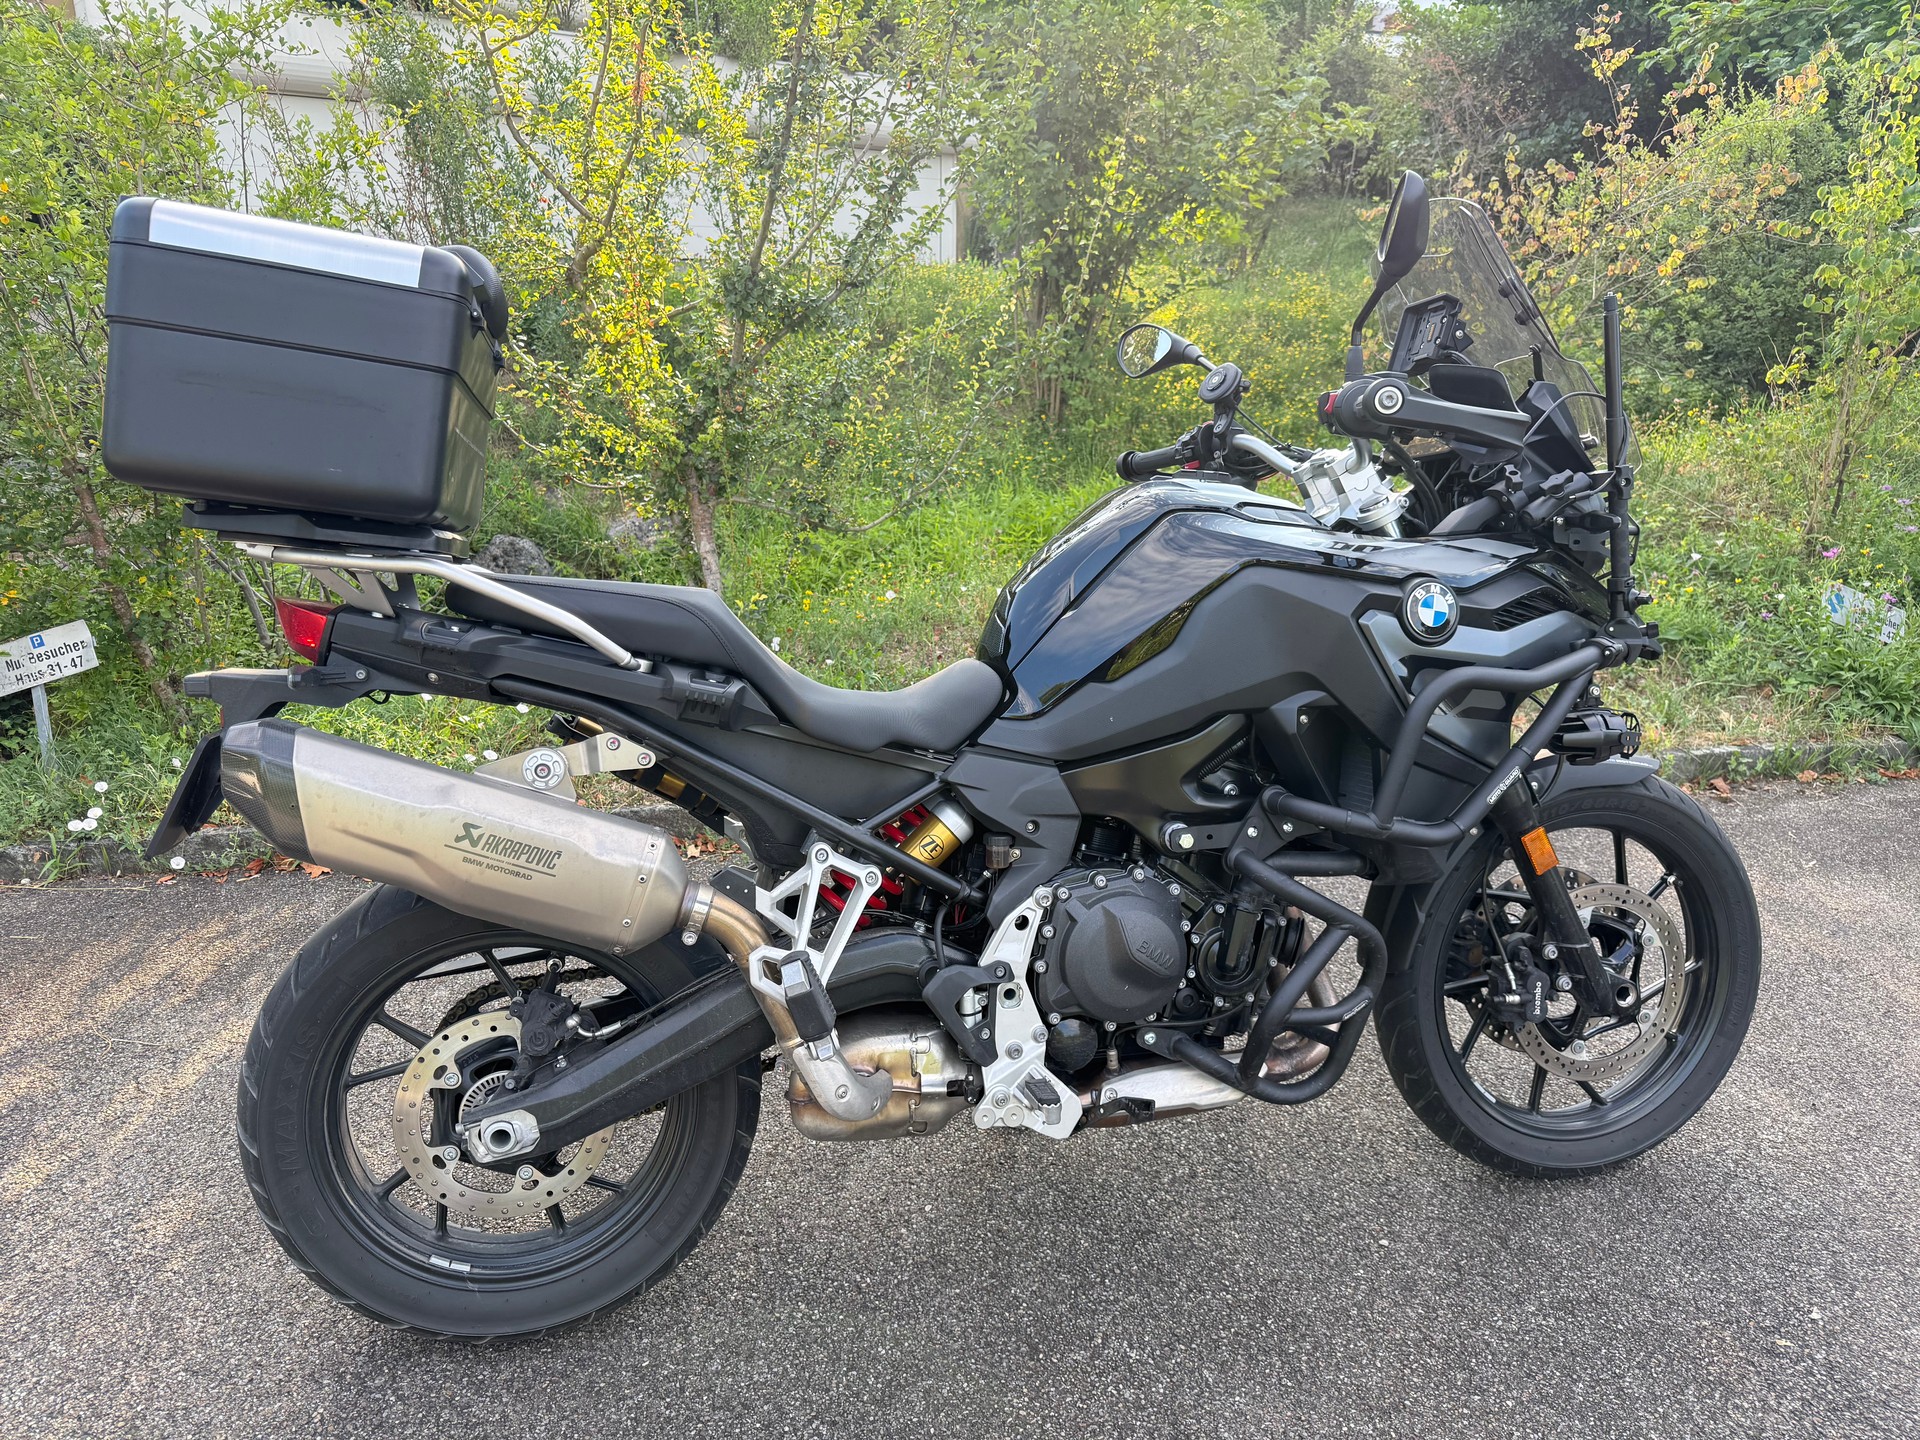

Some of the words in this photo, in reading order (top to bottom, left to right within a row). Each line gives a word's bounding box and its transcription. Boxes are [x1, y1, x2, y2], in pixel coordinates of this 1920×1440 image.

[1415, 584, 1455, 605] BMW
[27, 640, 88, 664] Besucher
[33, 636, 41, 647] P
[1489, 788, 1502, 804] MOTO
[481, 834, 563, 870] AKRAPOVIČ
[919, 835, 944, 860] ZF
[462, 856, 485, 867] BMW
[485, 862, 533, 881] MOTORRAD
[1136, 940, 1175, 970] BMW
[1533, 981, 1542, 1015] brembo
[275, 1022, 320, 1171] MAXXIS
